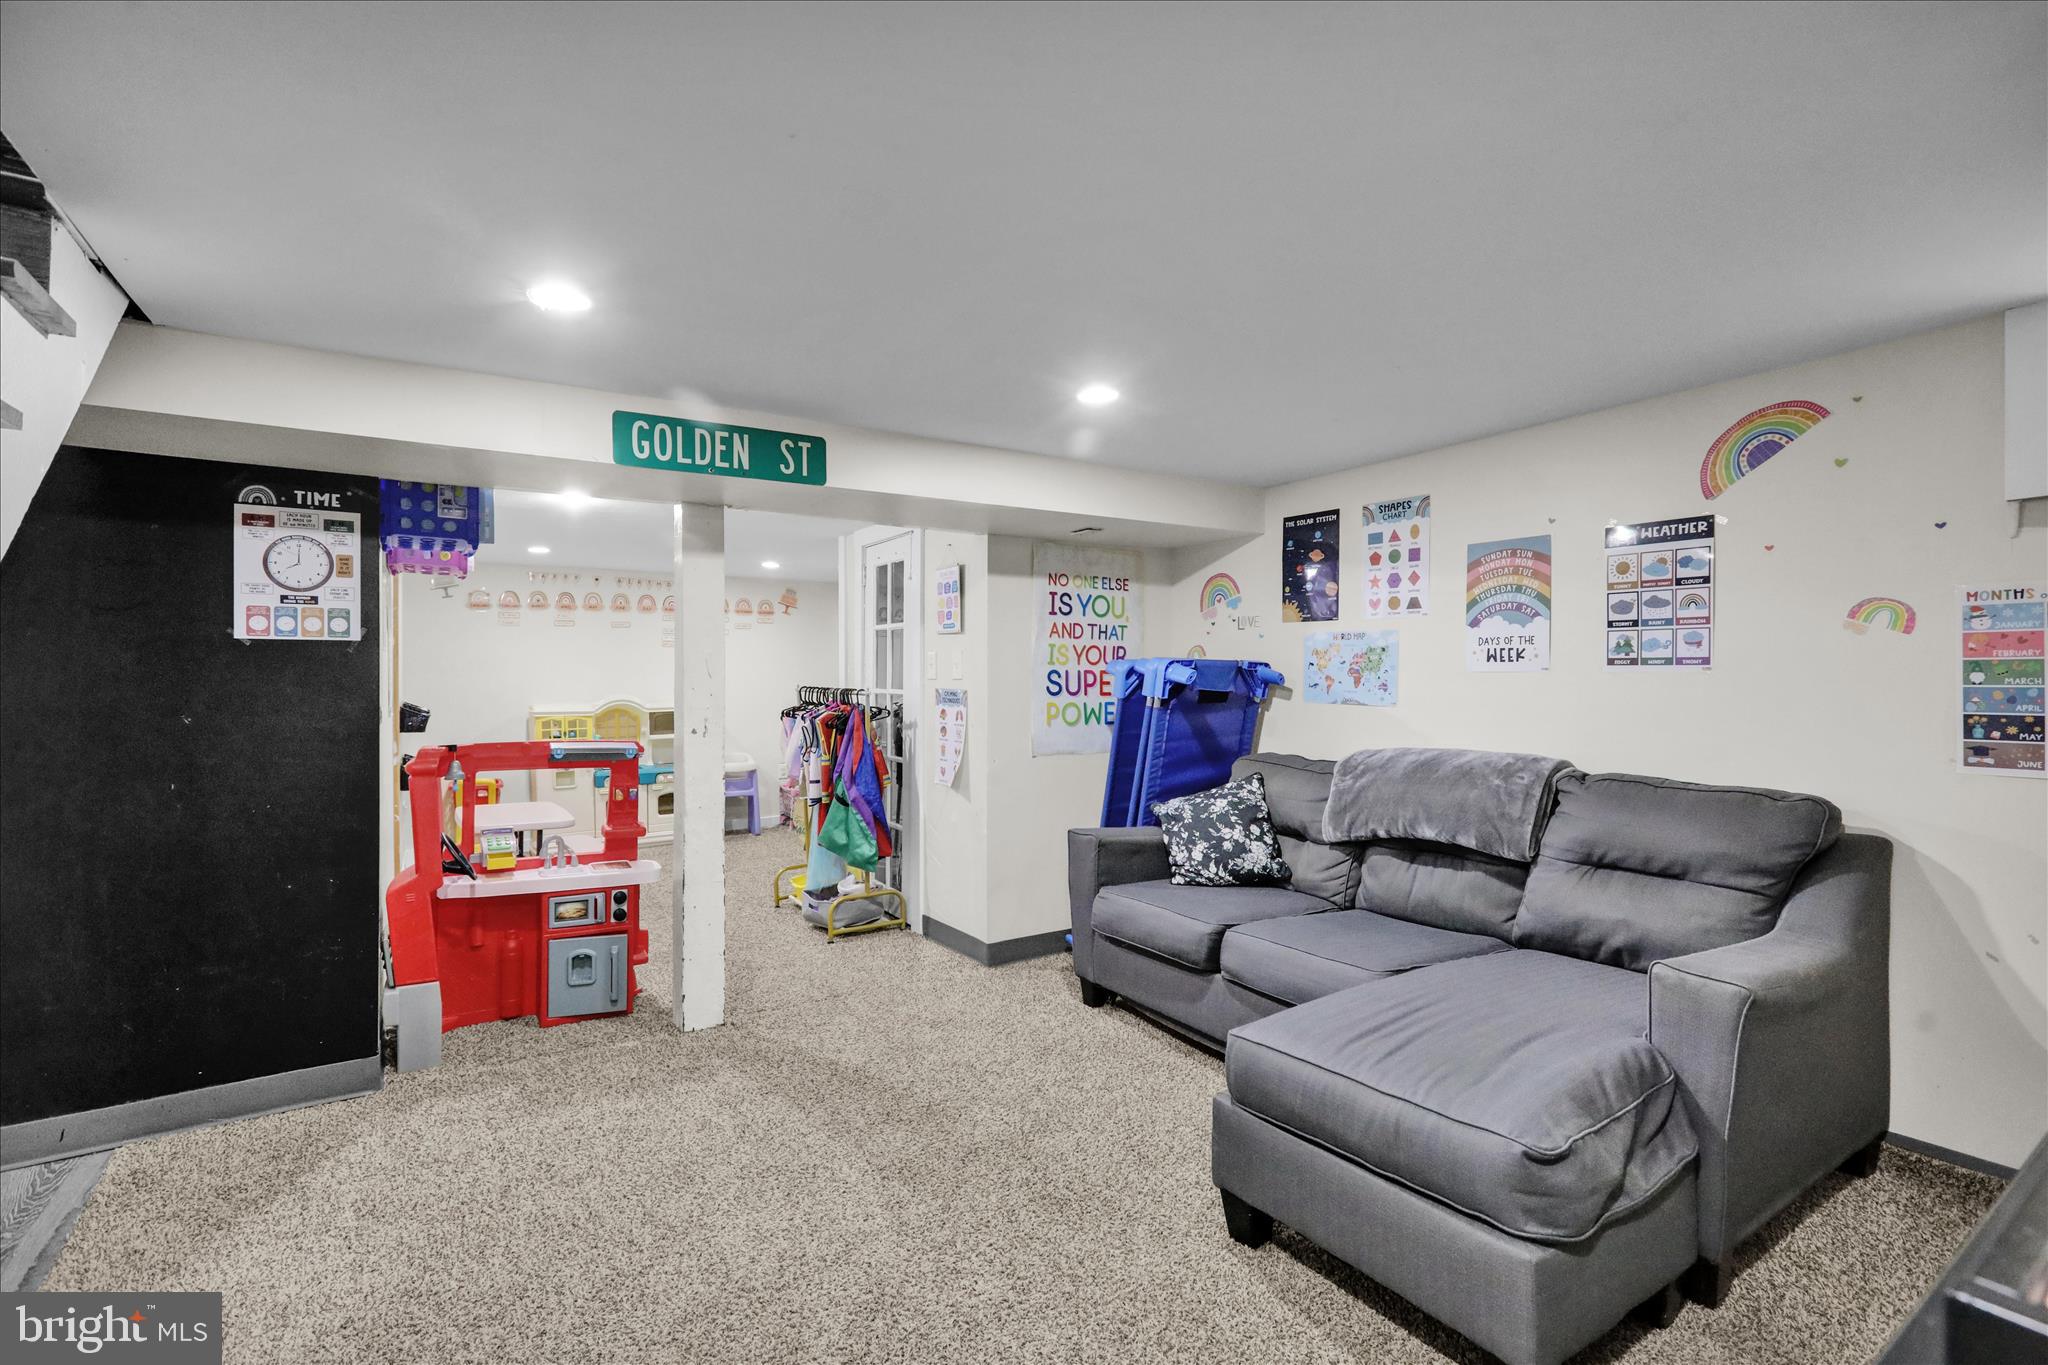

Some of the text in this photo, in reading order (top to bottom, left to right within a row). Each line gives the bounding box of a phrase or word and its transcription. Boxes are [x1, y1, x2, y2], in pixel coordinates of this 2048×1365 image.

[631, 420, 811, 476] GOLDEN ST
[294, 490, 341, 507] TIME
[1379, 500, 1412, 514] SHAPES
[1316, 514, 1337, 523] SYSTEM
[1383, 510, 1407, 520] CHART
[1641, 521, 1708, 539] WEATHER
[1481, 550, 1534, 564] SUNDAY SUN.
[1479, 558, 1511, 573] MONDAY
[1480, 567, 1535, 581] TUESDAY TUE.
[1049, 573, 1129, 591] NO ONE ELSE
[1476, 585, 1517, 602] THURSDAY
[1966, 588, 2034, 601] MONTHS
[1049, 592, 1072, 616] IS
[1478, 603, 1518, 620] SATURDAY
[1238, 616, 1260, 630] LOVE
[1995, 621, 2042, 629] JANUARY
[1050, 622, 1128, 640] AND THAT
[1478, 636, 1535, 646] DAYS OF THE
[1048, 643, 1127, 666] IS YOUR
[1487, 648, 1525, 662] WEEK
[1992, 649, 2042, 657] FEBRUARY
[1046, 670, 1111, 696] SUPE
[1046, 702, 1115, 726] POWE
[2019, 733, 2043, 741] MAY
[2017, 760, 2043, 768] JUNE
